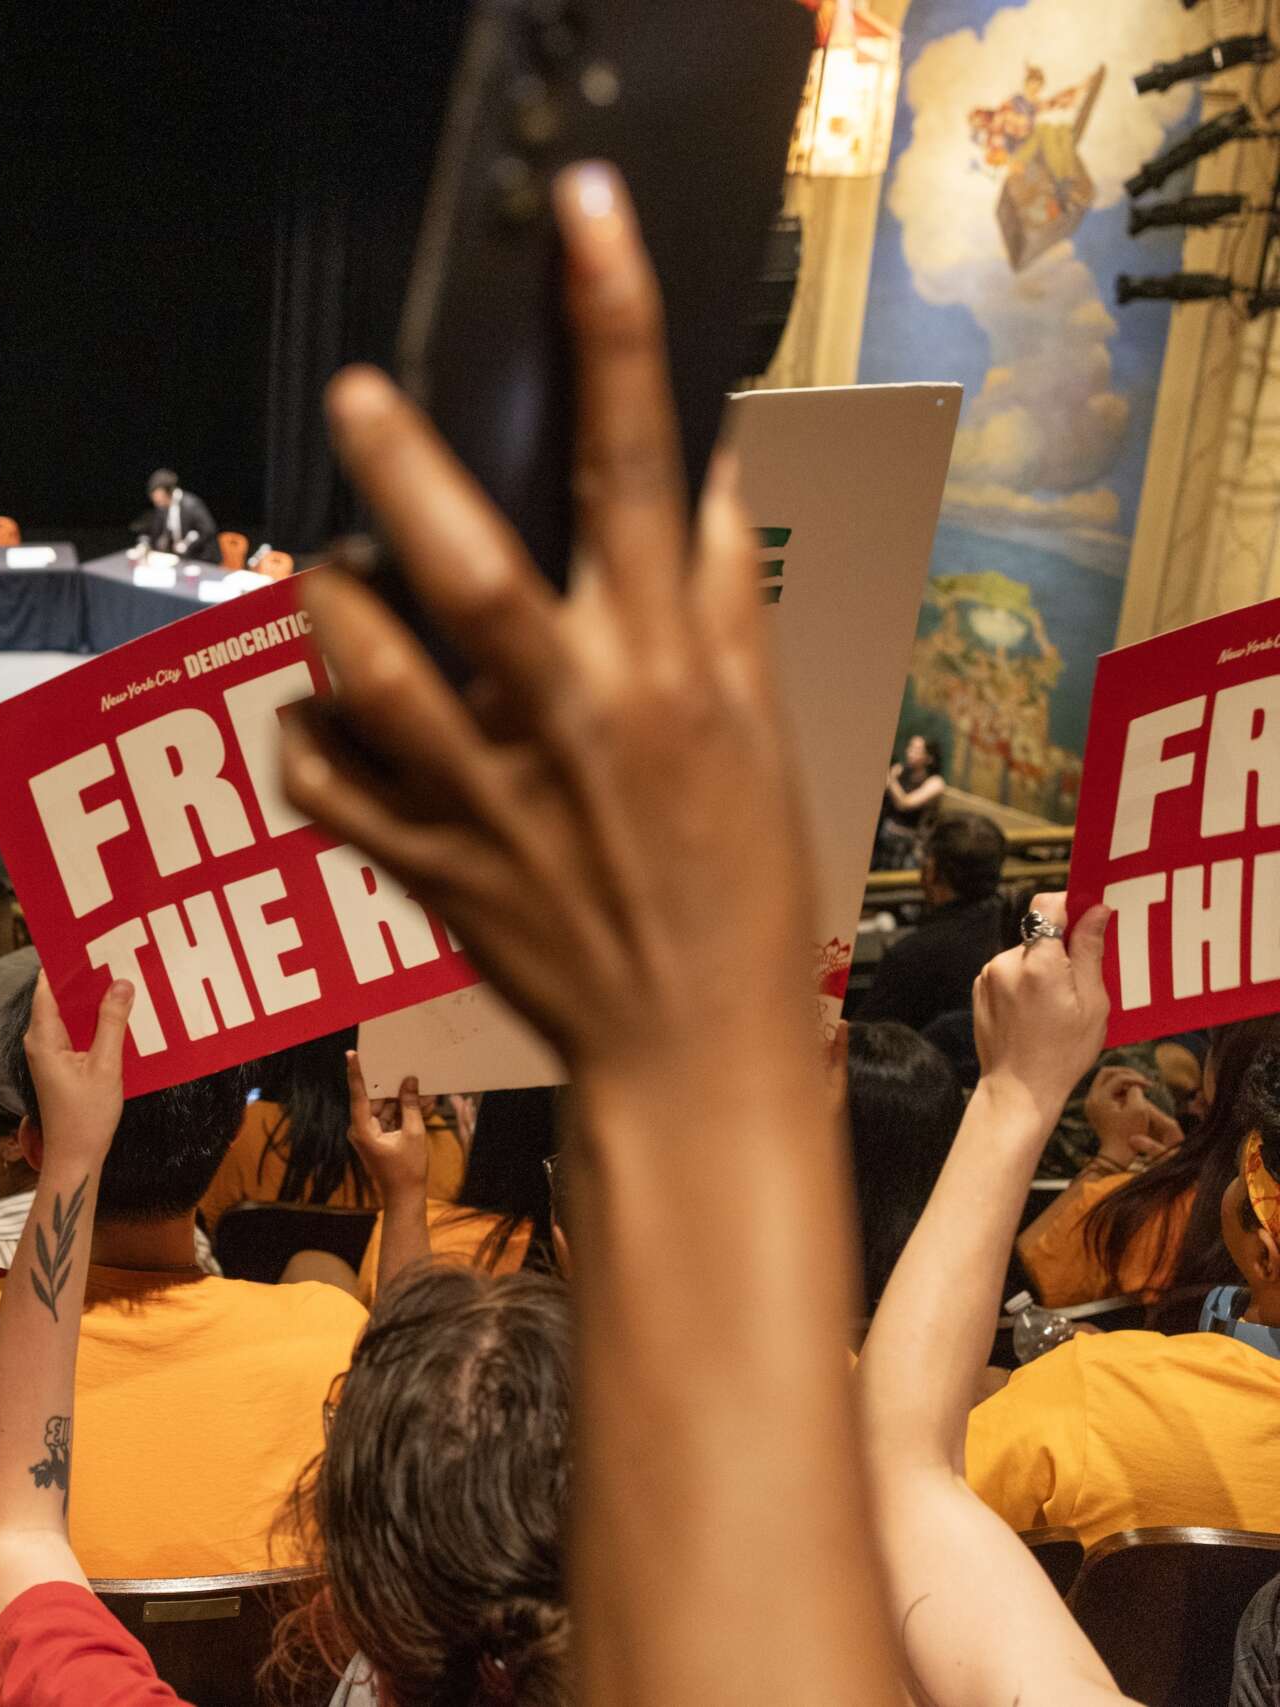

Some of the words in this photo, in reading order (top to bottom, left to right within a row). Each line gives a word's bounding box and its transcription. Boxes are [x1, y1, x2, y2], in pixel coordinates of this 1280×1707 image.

[101, 693, 128, 712] New
[155, 667, 182, 687] City
[183, 610, 313, 679] DEMOCRATIC
[29, 660, 318, 919] FRE
[86, 868, 322, 1058] THE
